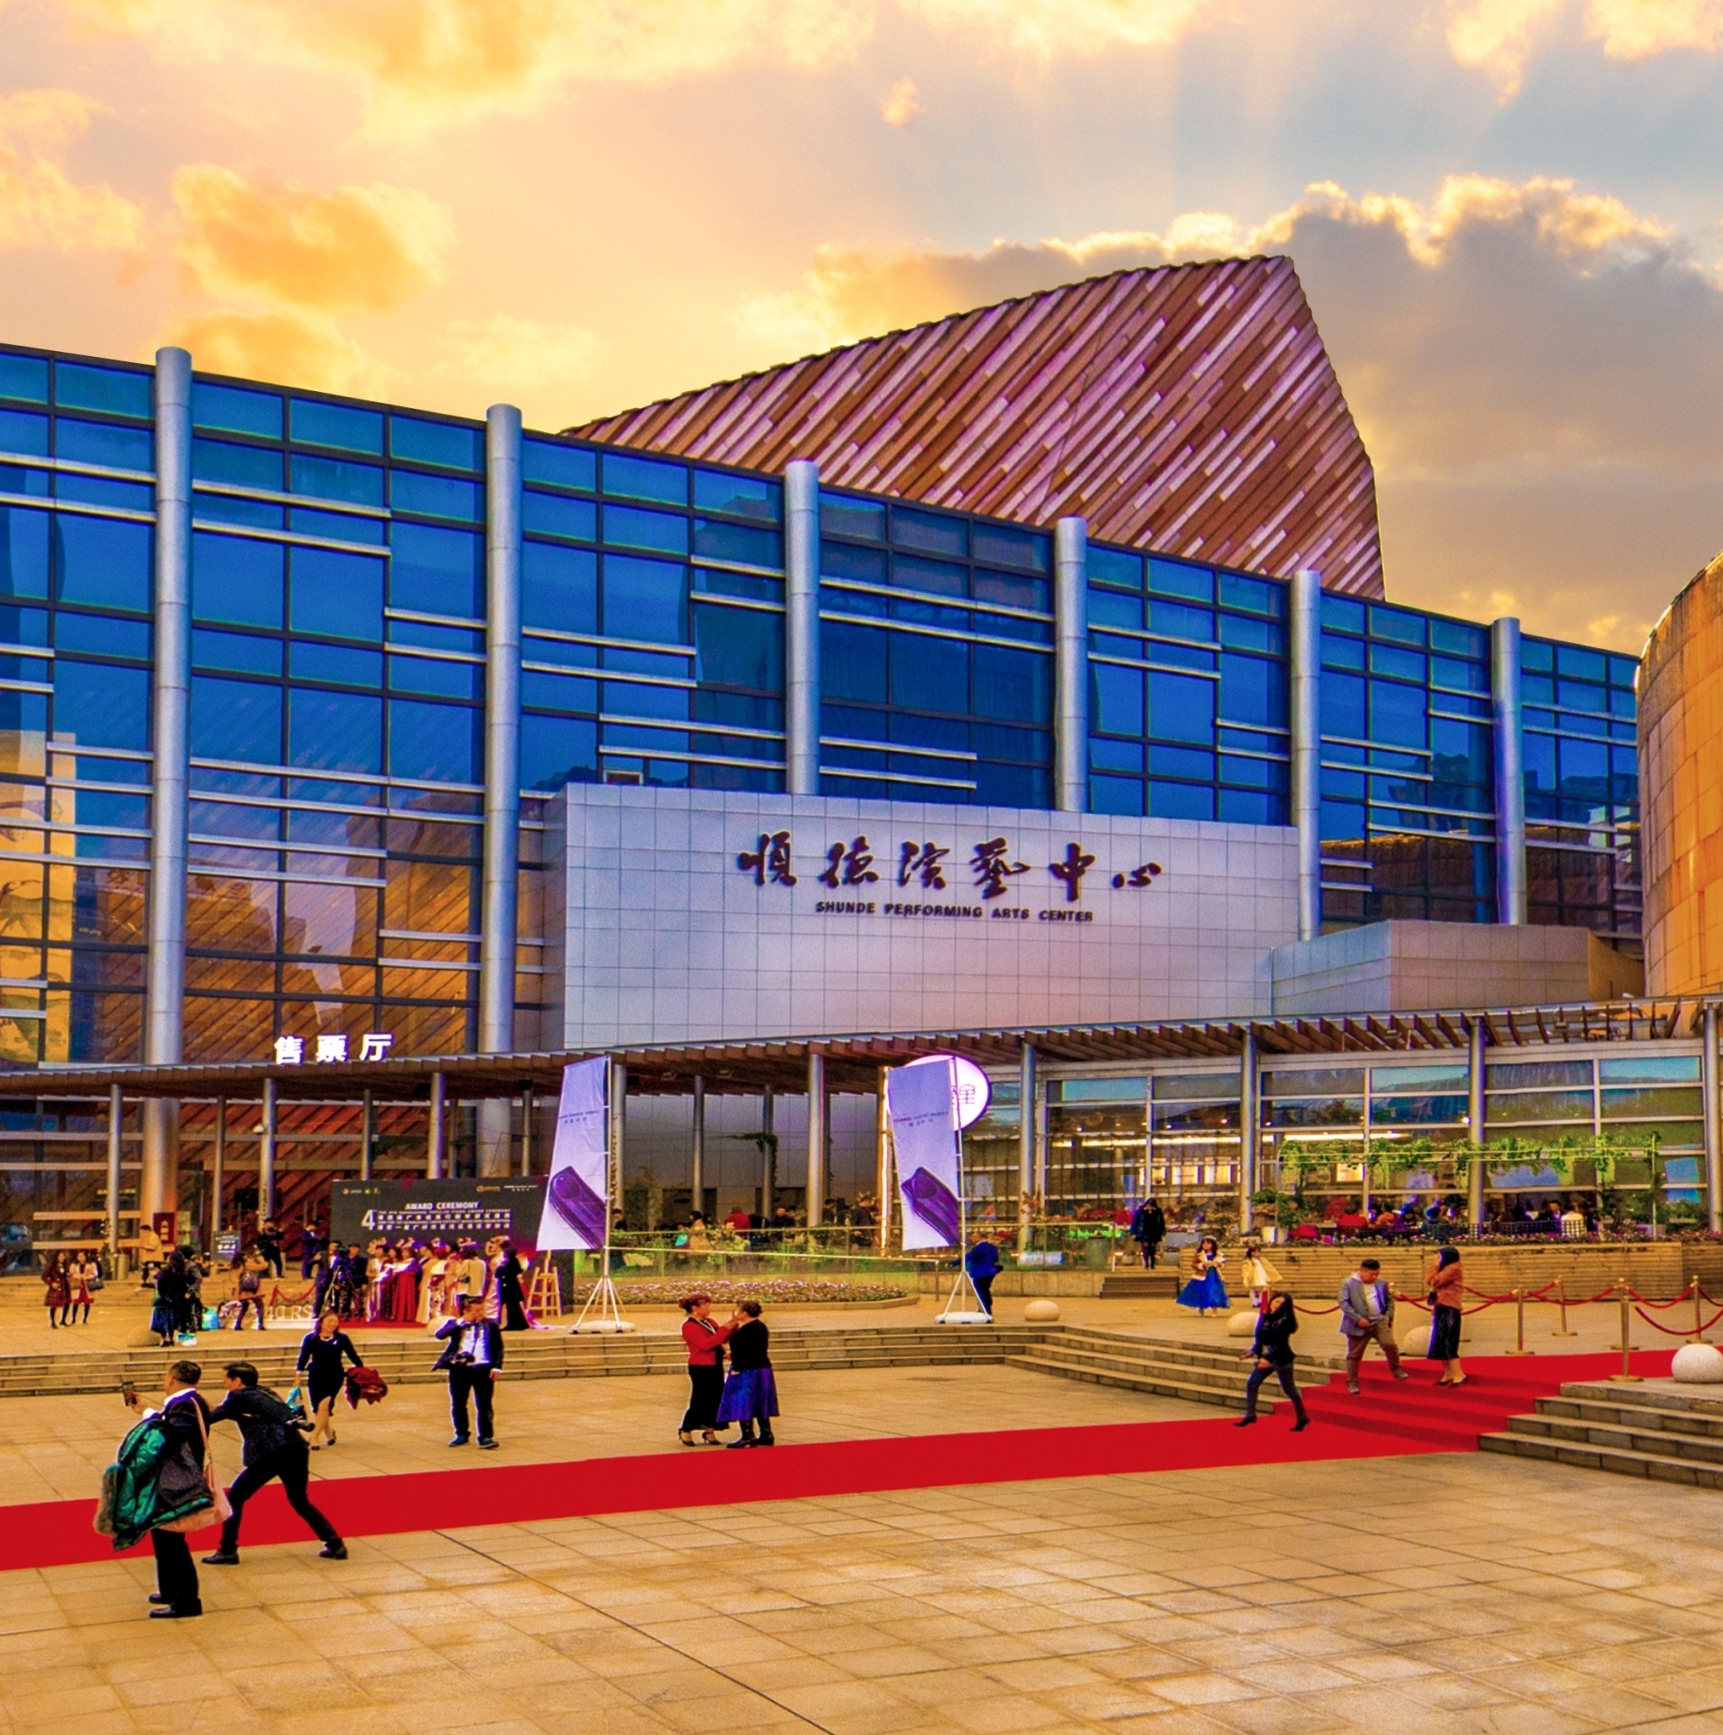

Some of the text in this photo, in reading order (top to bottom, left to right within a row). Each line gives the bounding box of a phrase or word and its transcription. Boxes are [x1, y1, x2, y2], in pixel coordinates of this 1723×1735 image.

[816, 901, 1094, 922] SHUNDE PERFORMING ARTS CENTER
[274, 1034, 393, 1065] 售票厅
